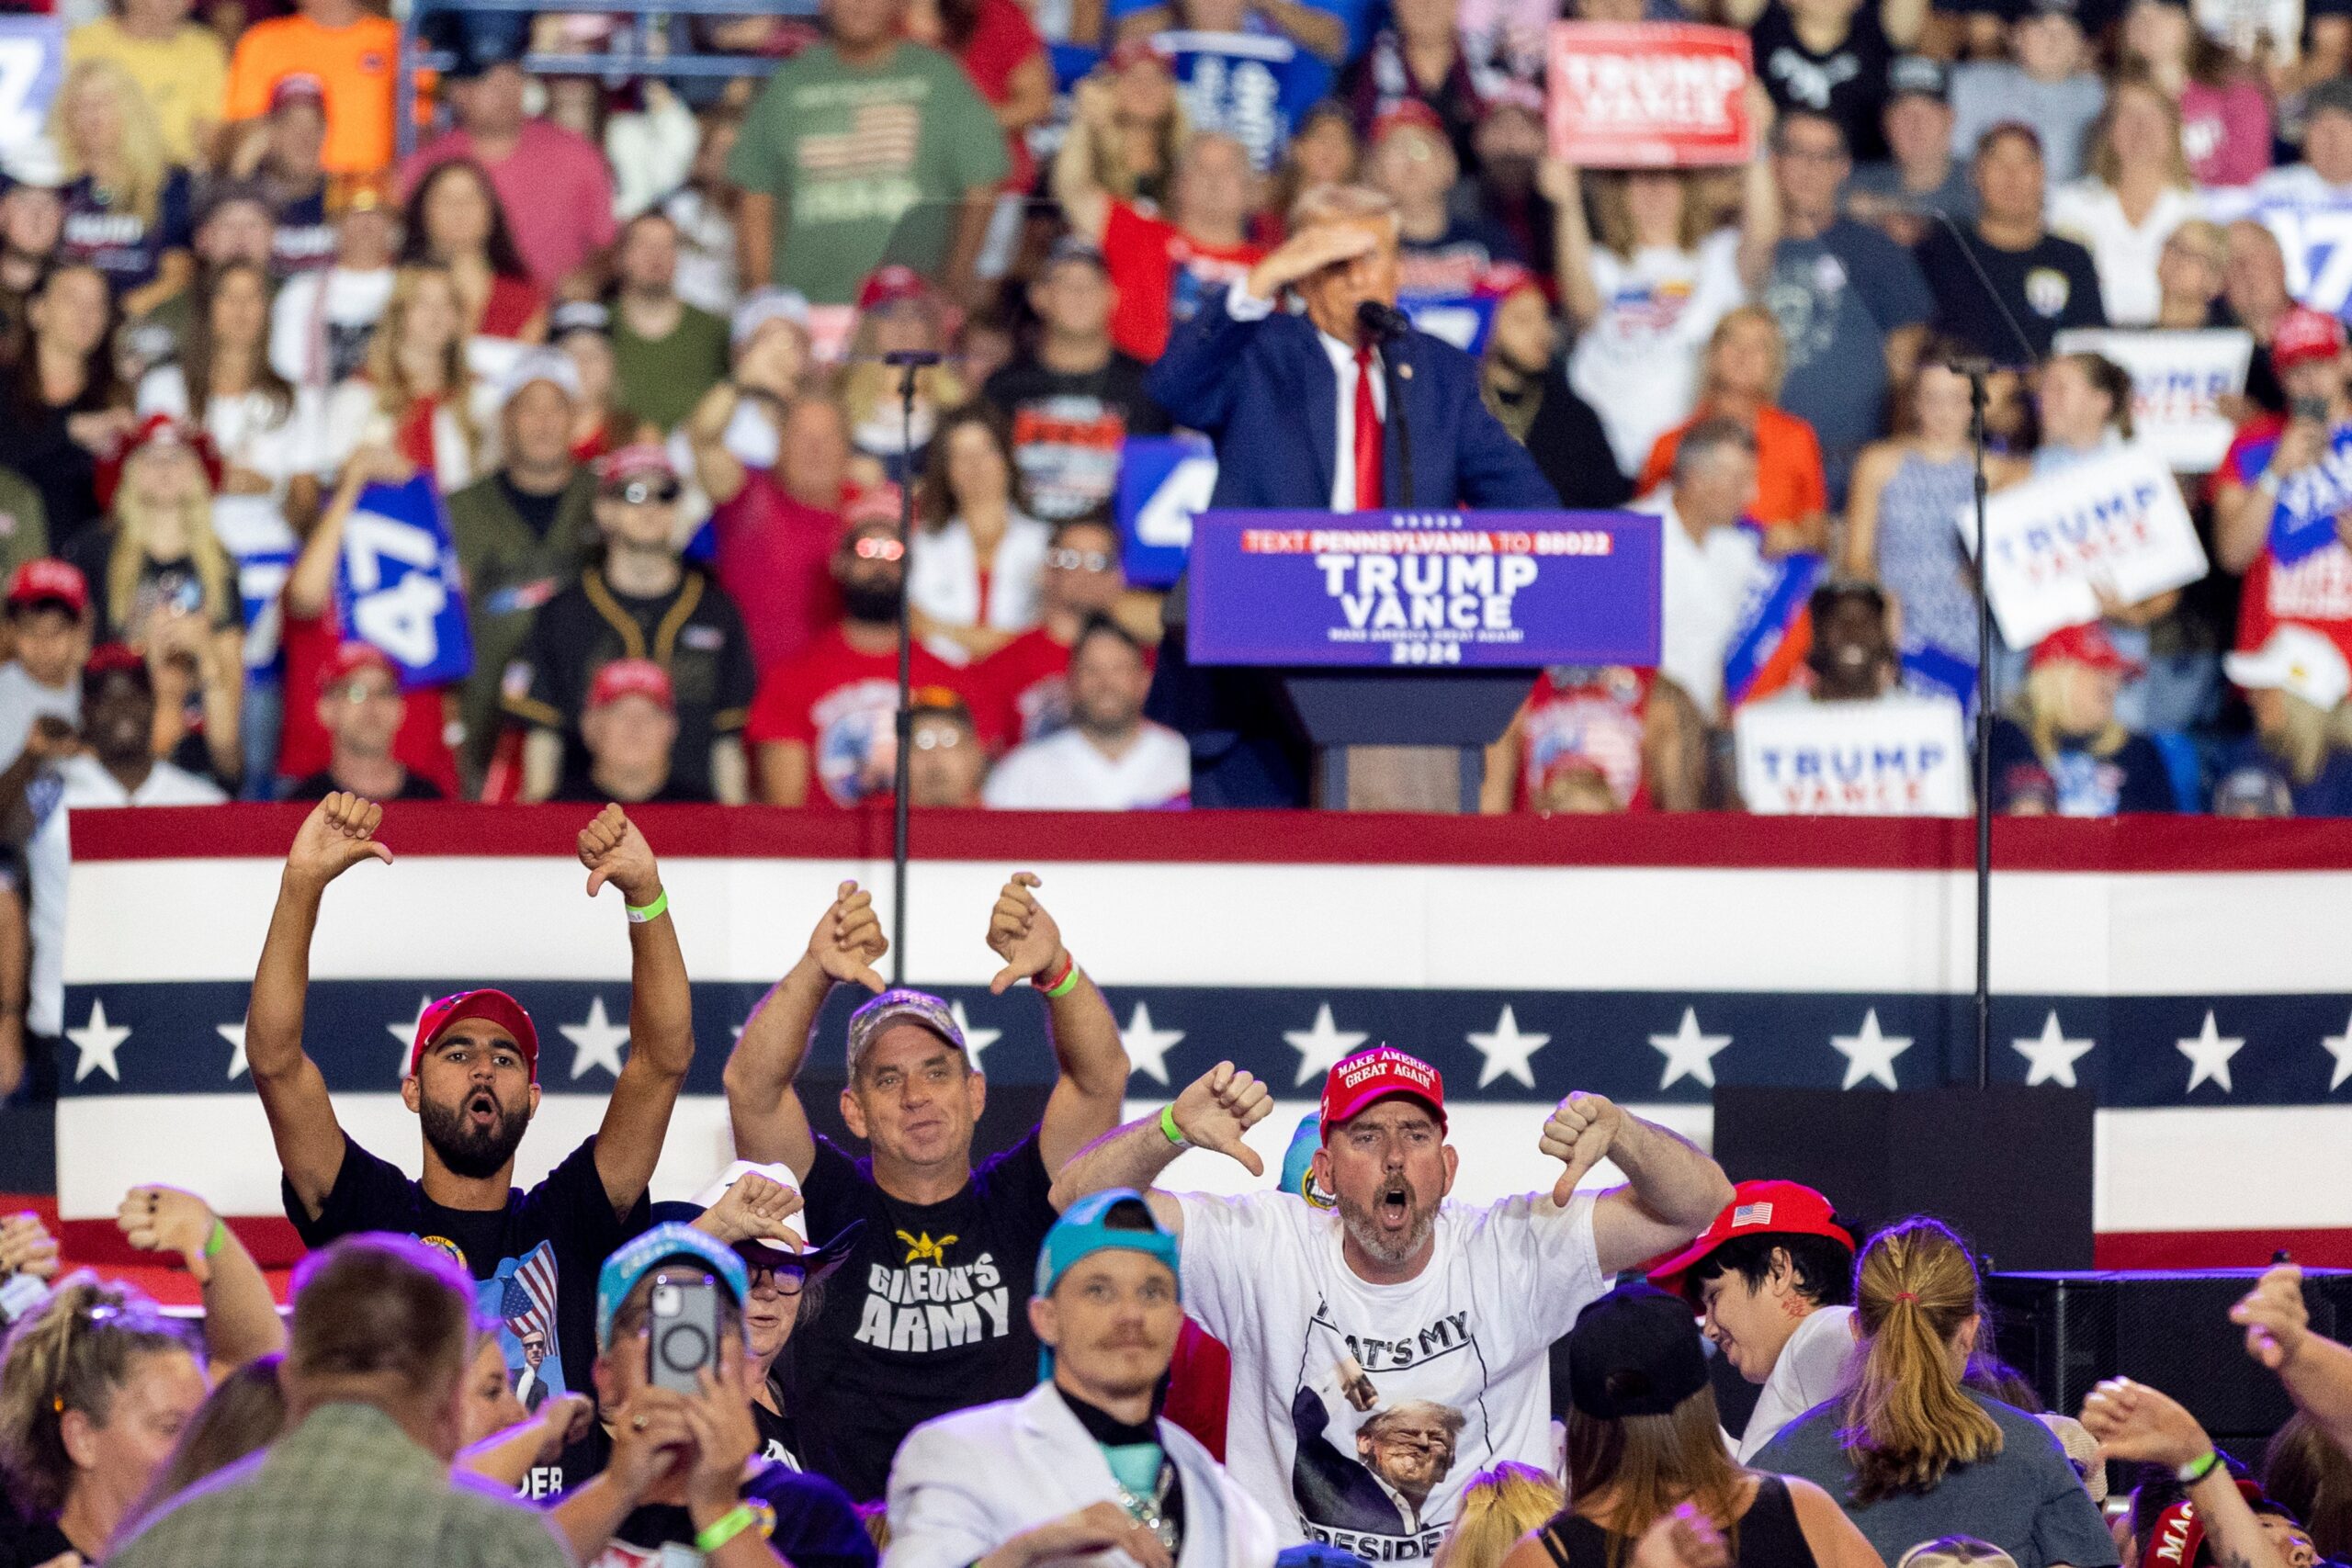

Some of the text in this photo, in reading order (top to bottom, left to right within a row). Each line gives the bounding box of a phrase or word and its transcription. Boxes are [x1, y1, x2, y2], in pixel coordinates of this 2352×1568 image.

[1247, 530, 1309, 553] TEXT
[1311, 530, 1493, 554] PENNSYLVANIA
[1498, 531, 1532, 554] TO
[1994, 481, 2157, 566] TRUMP
[1316, 555, 1538, 597] TRUMP
[1340, 594, 1512, 628] VANCE
[1392, 642, 1461, 664] 2024
[1762, 743, 1943, 783] TRUMP
[1339, 1050, 1436, 1082] MAKE AMERICA
[1345, 1062, 1430, 1089] GREAT AGAIN
[854, 1287, 1010, 1353] ARMY
[1419, 1311, 1469, 1357] MY
[1299, 1516, 1452, 1562] RESIDE
